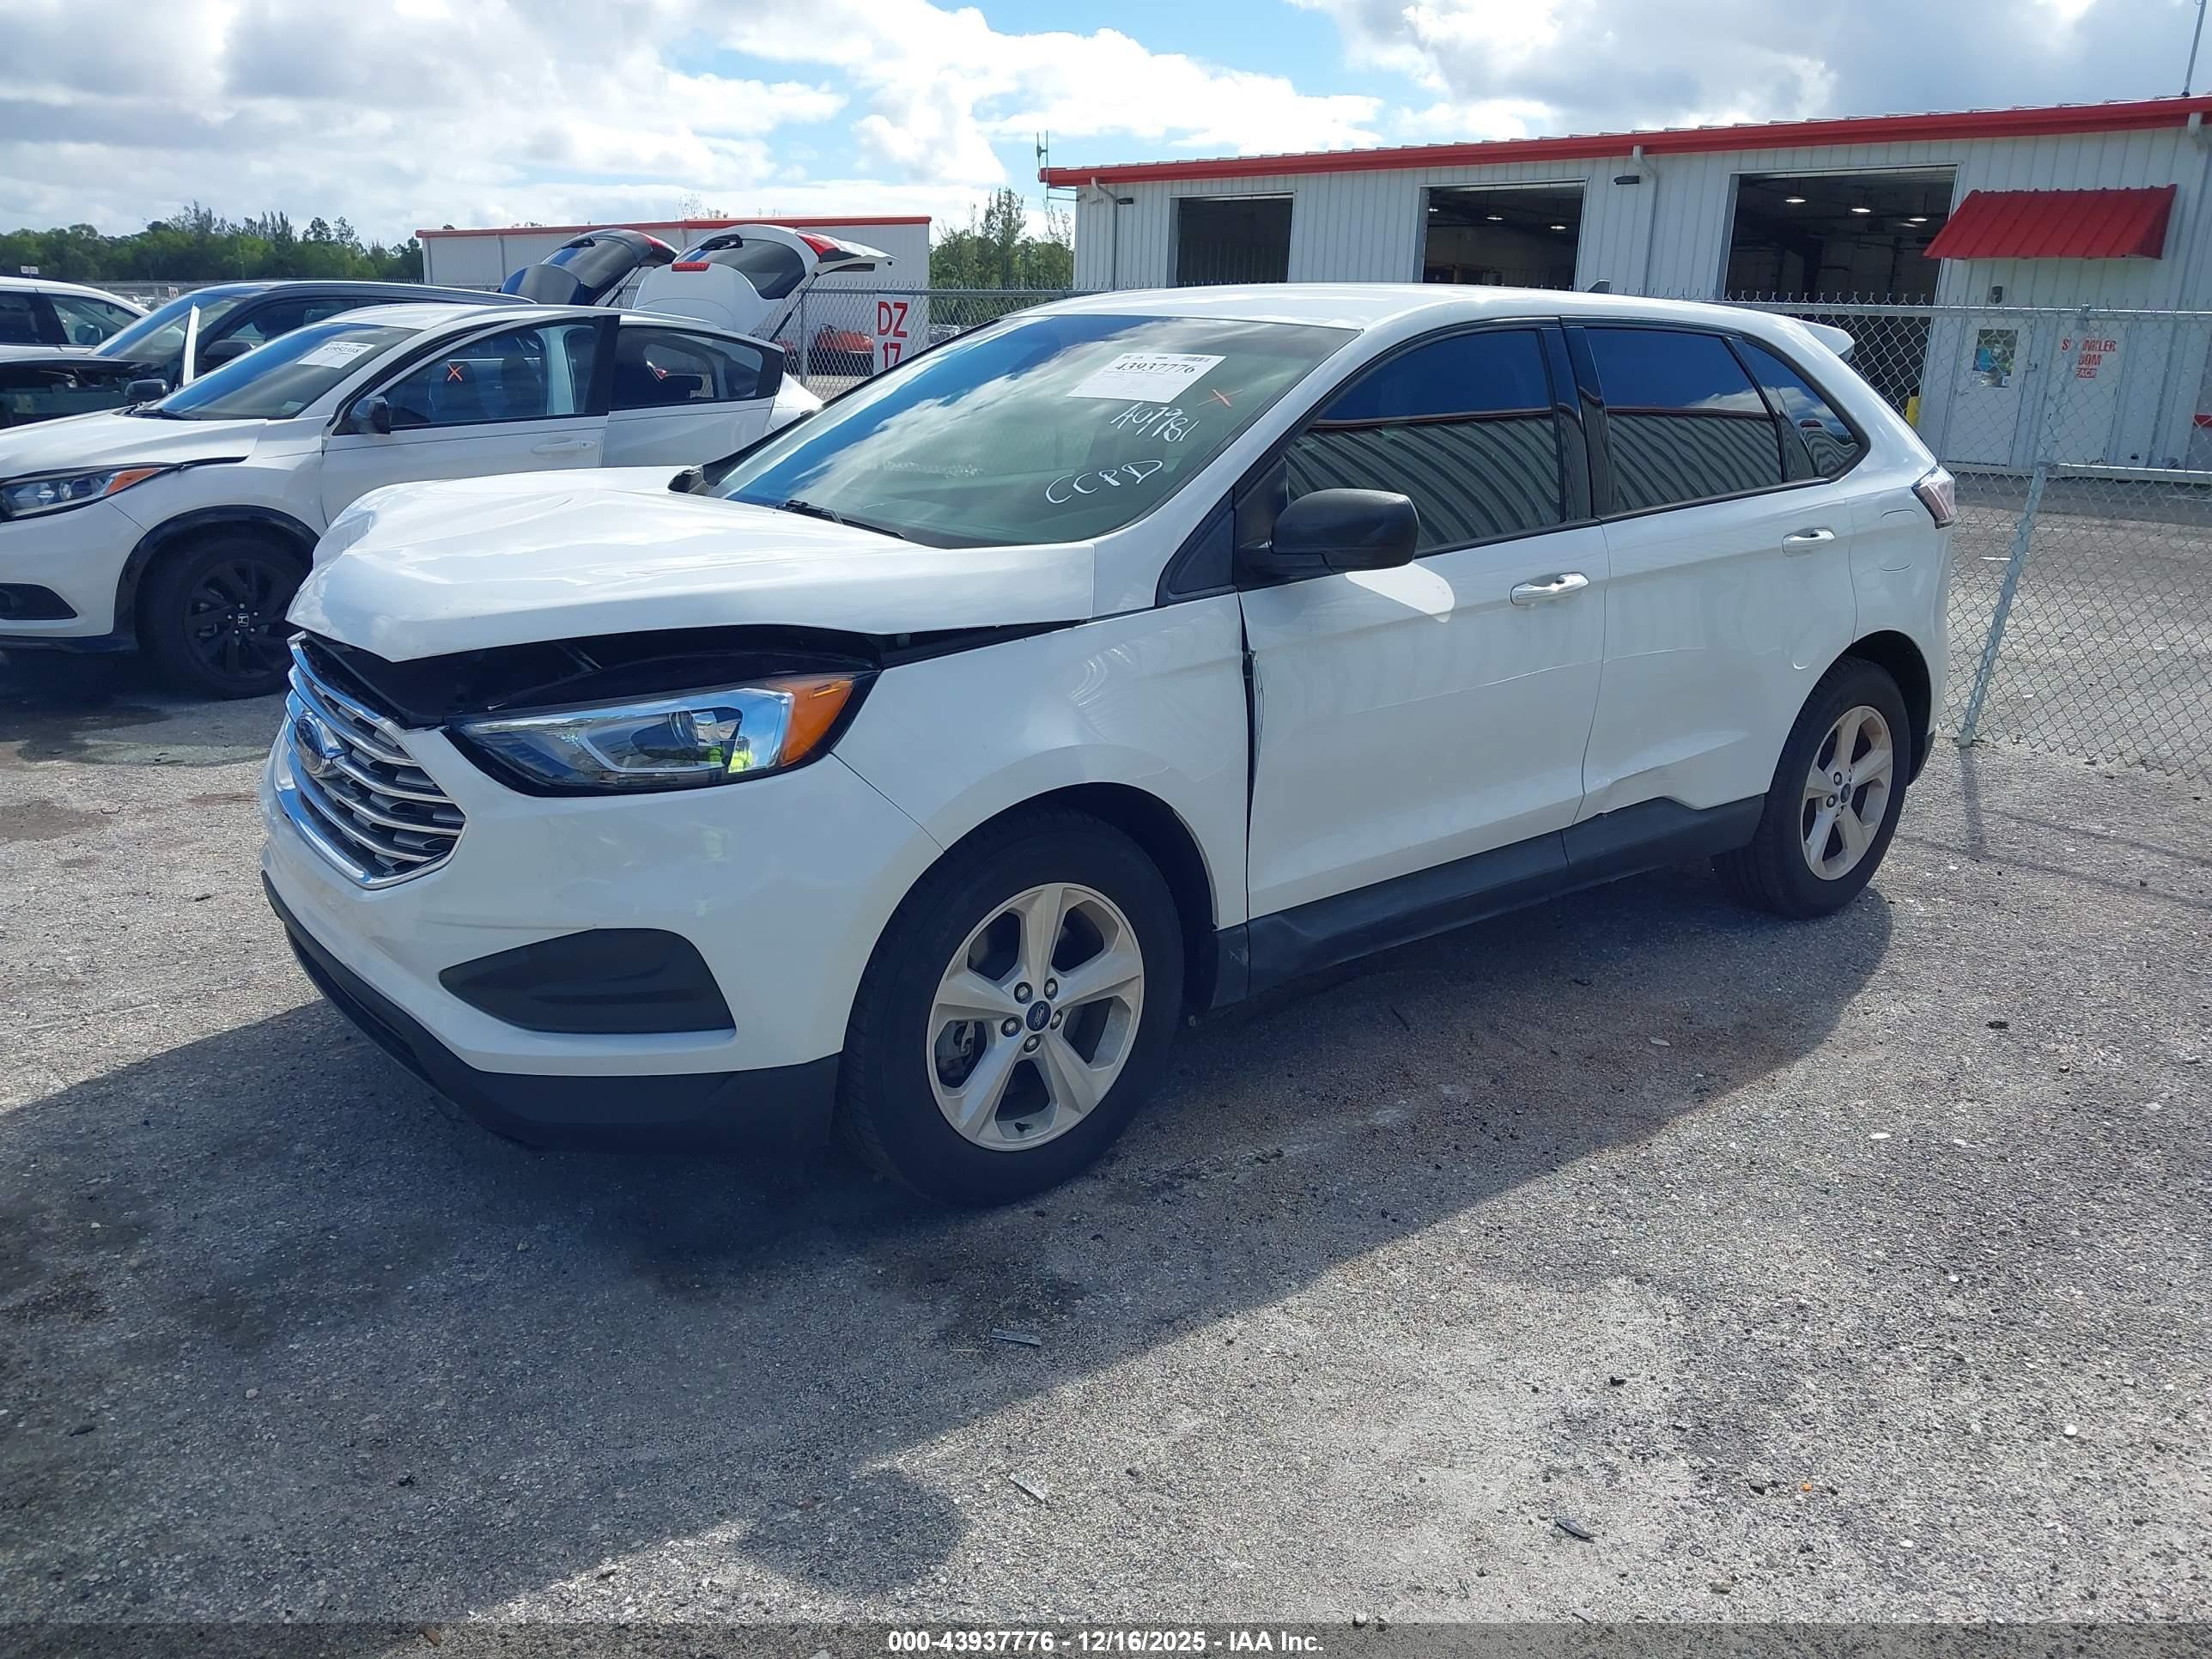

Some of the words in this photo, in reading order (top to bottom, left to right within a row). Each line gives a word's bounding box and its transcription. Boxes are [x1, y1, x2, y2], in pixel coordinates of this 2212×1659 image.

[878, 301, 908, 337] DZ
[882, 342, 902, 369] 17
[1115, 362, 1196, 374] 43937776
[1045, 459, 1164, 504] CCPD
